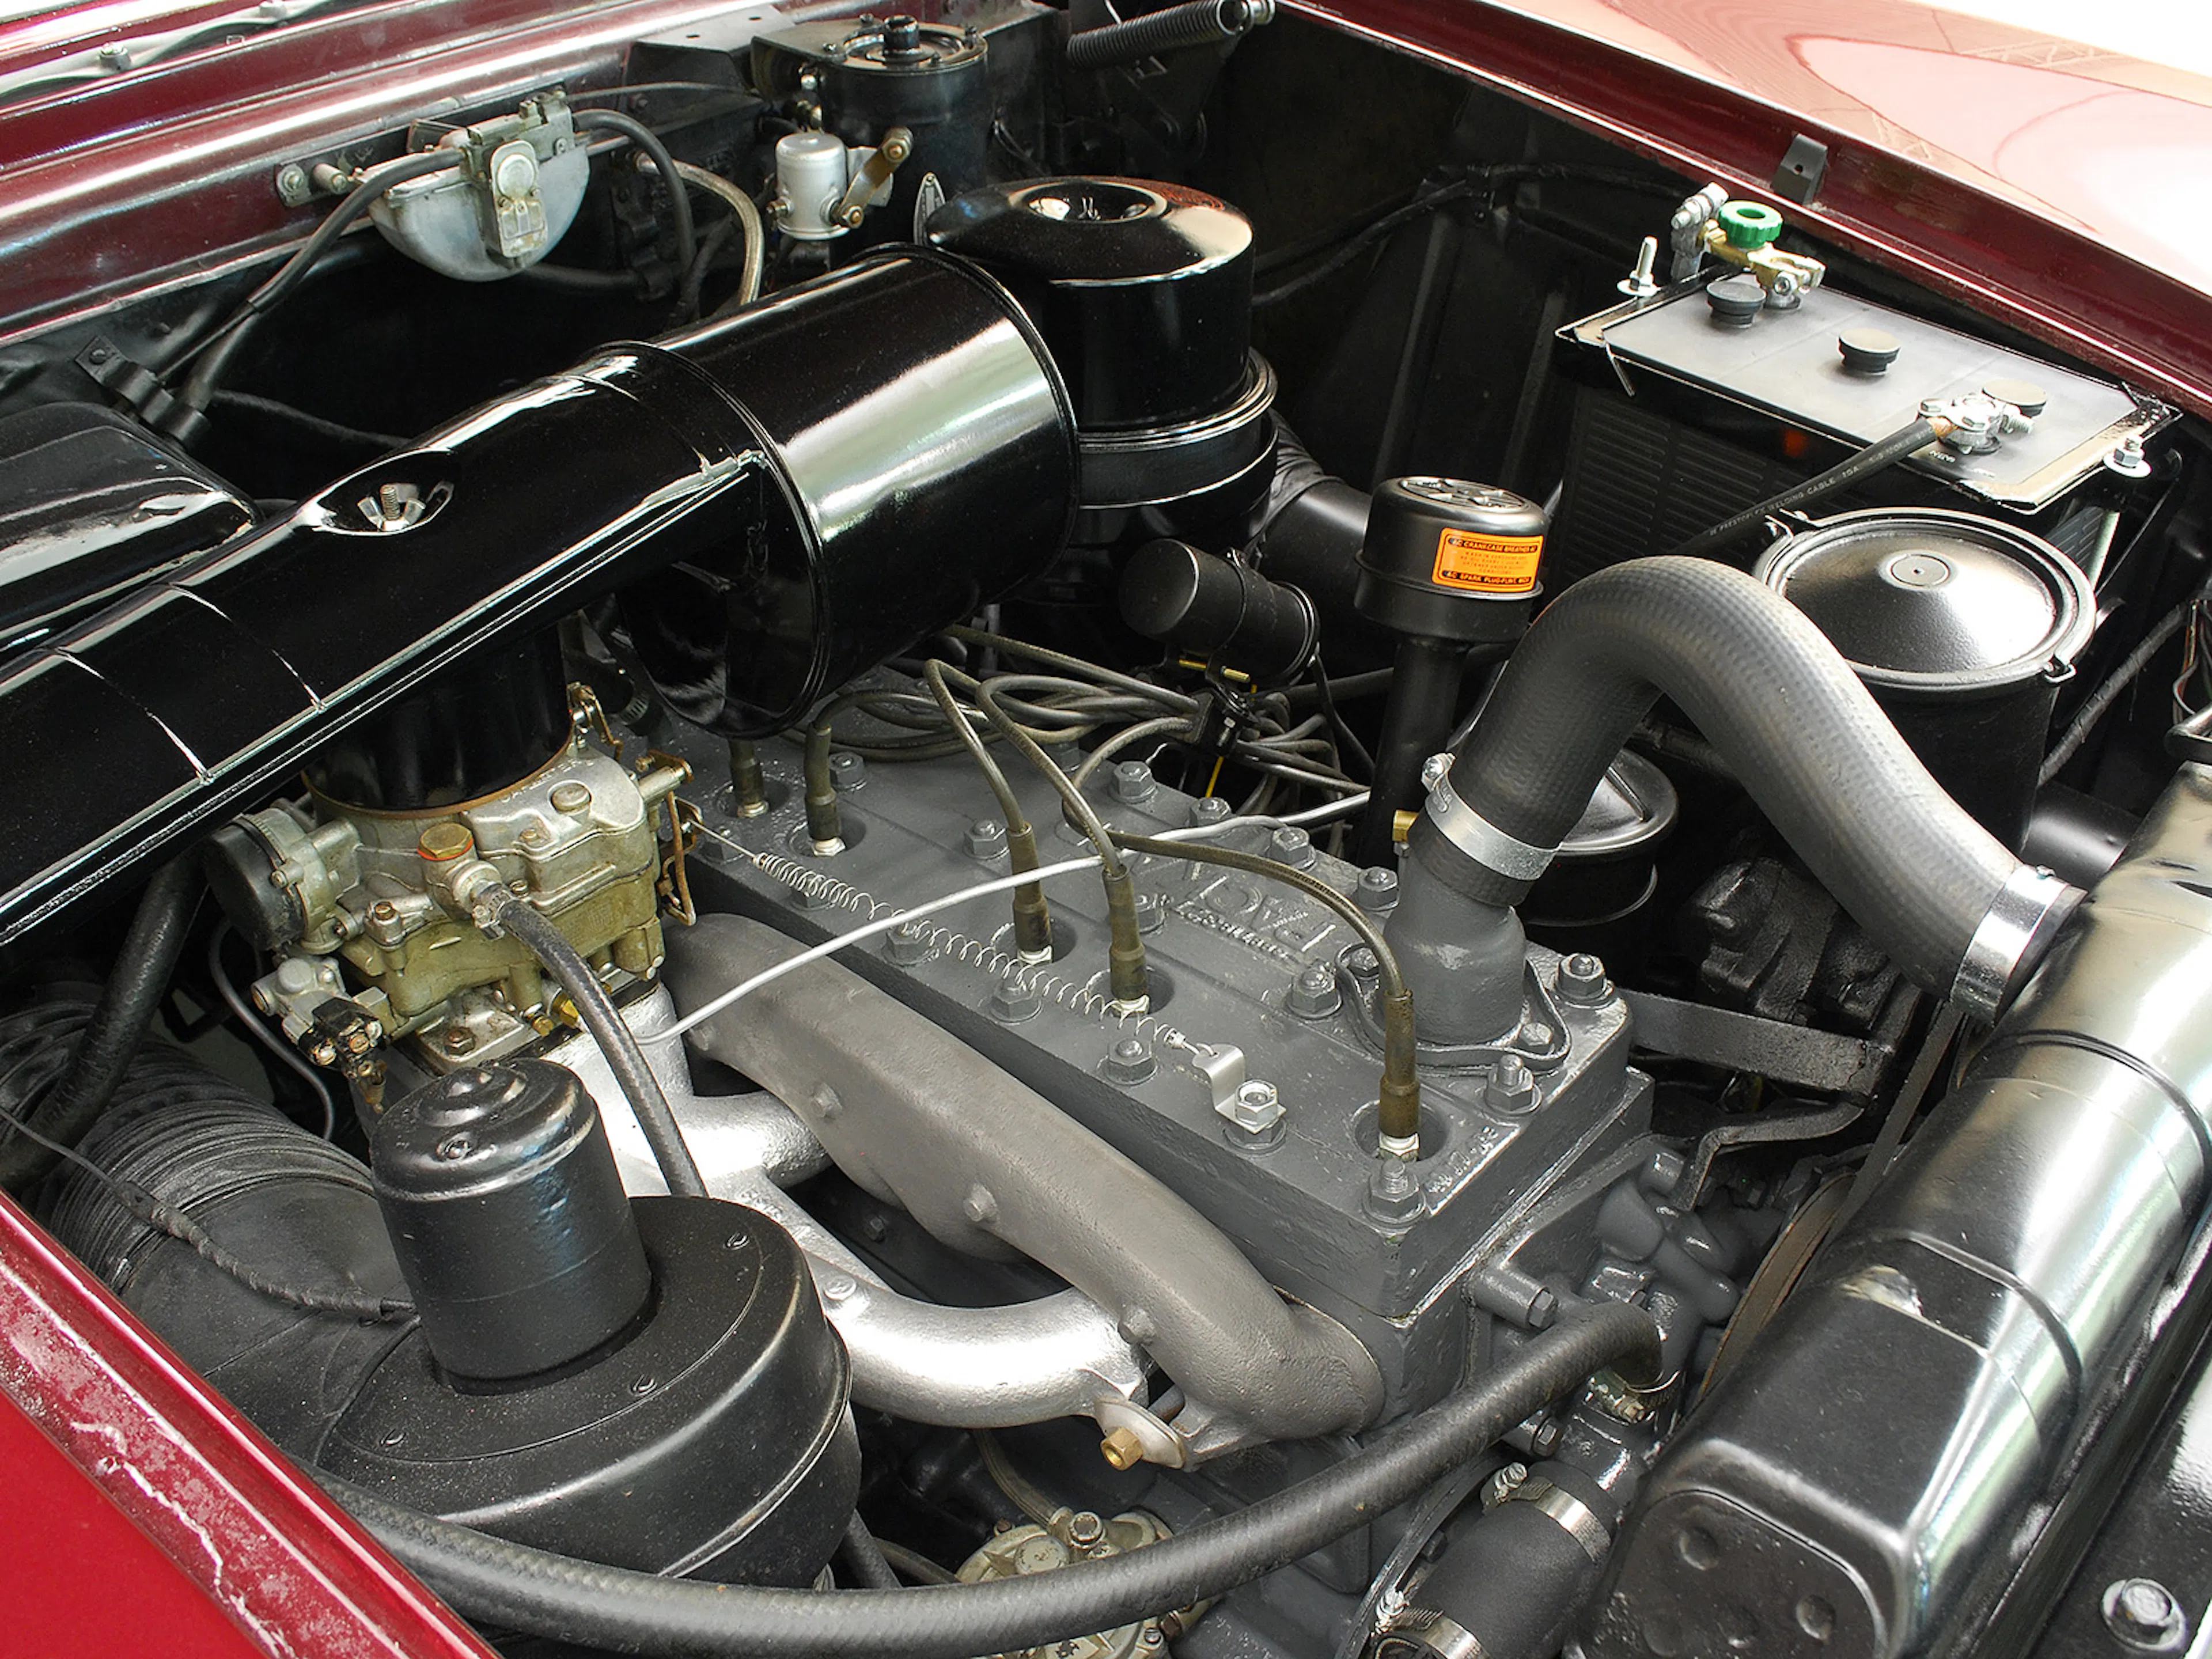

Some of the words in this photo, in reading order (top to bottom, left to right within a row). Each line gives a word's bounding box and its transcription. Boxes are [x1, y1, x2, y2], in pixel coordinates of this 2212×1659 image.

[1807, 478, 1836, 495] CABLE
[1463, 540, 1503, 552] CRANKCASE
[1459, 573, 1482, 582] SPARK
